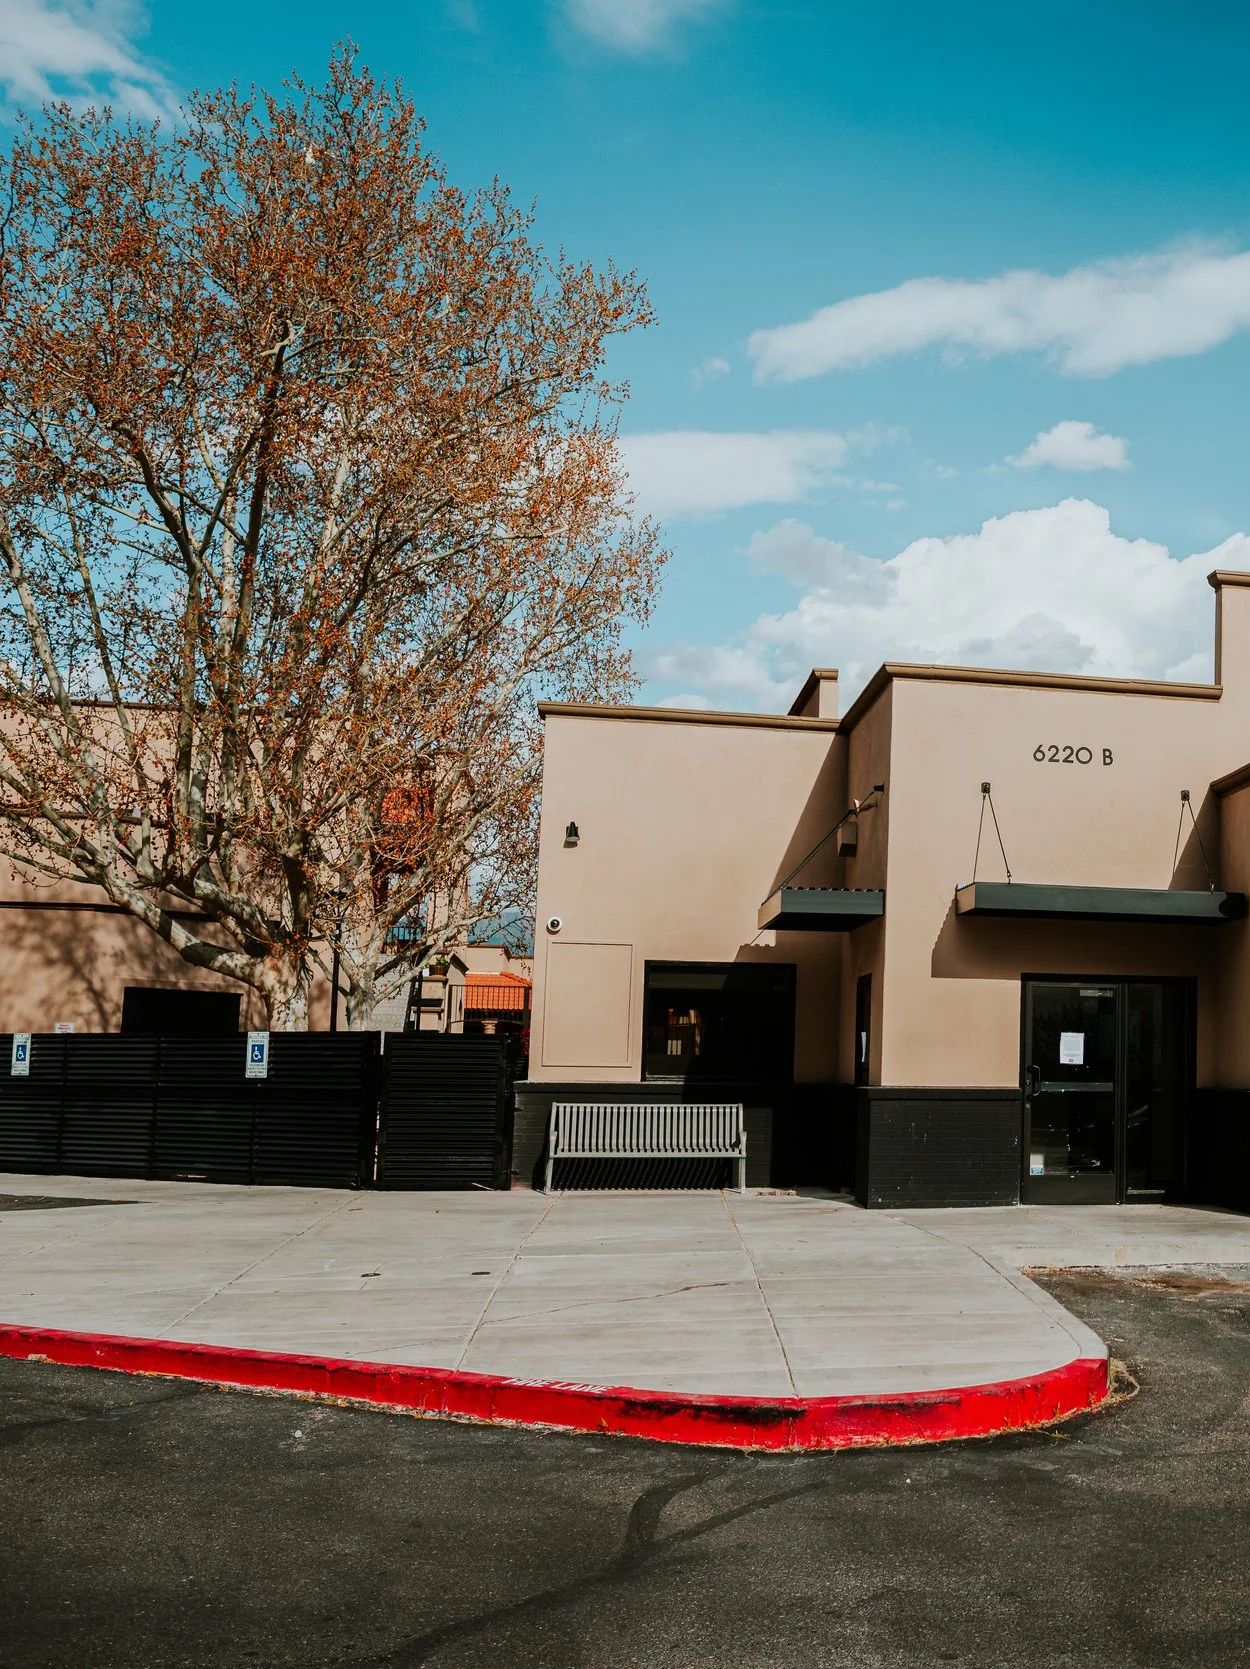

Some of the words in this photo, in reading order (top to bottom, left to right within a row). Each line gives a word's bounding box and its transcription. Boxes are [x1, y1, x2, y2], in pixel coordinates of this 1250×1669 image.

[1032, 743, 1093, 765] 6220
[1102, 747, 1114, 766] B
[550, 1382, 612, 1394] LANE
